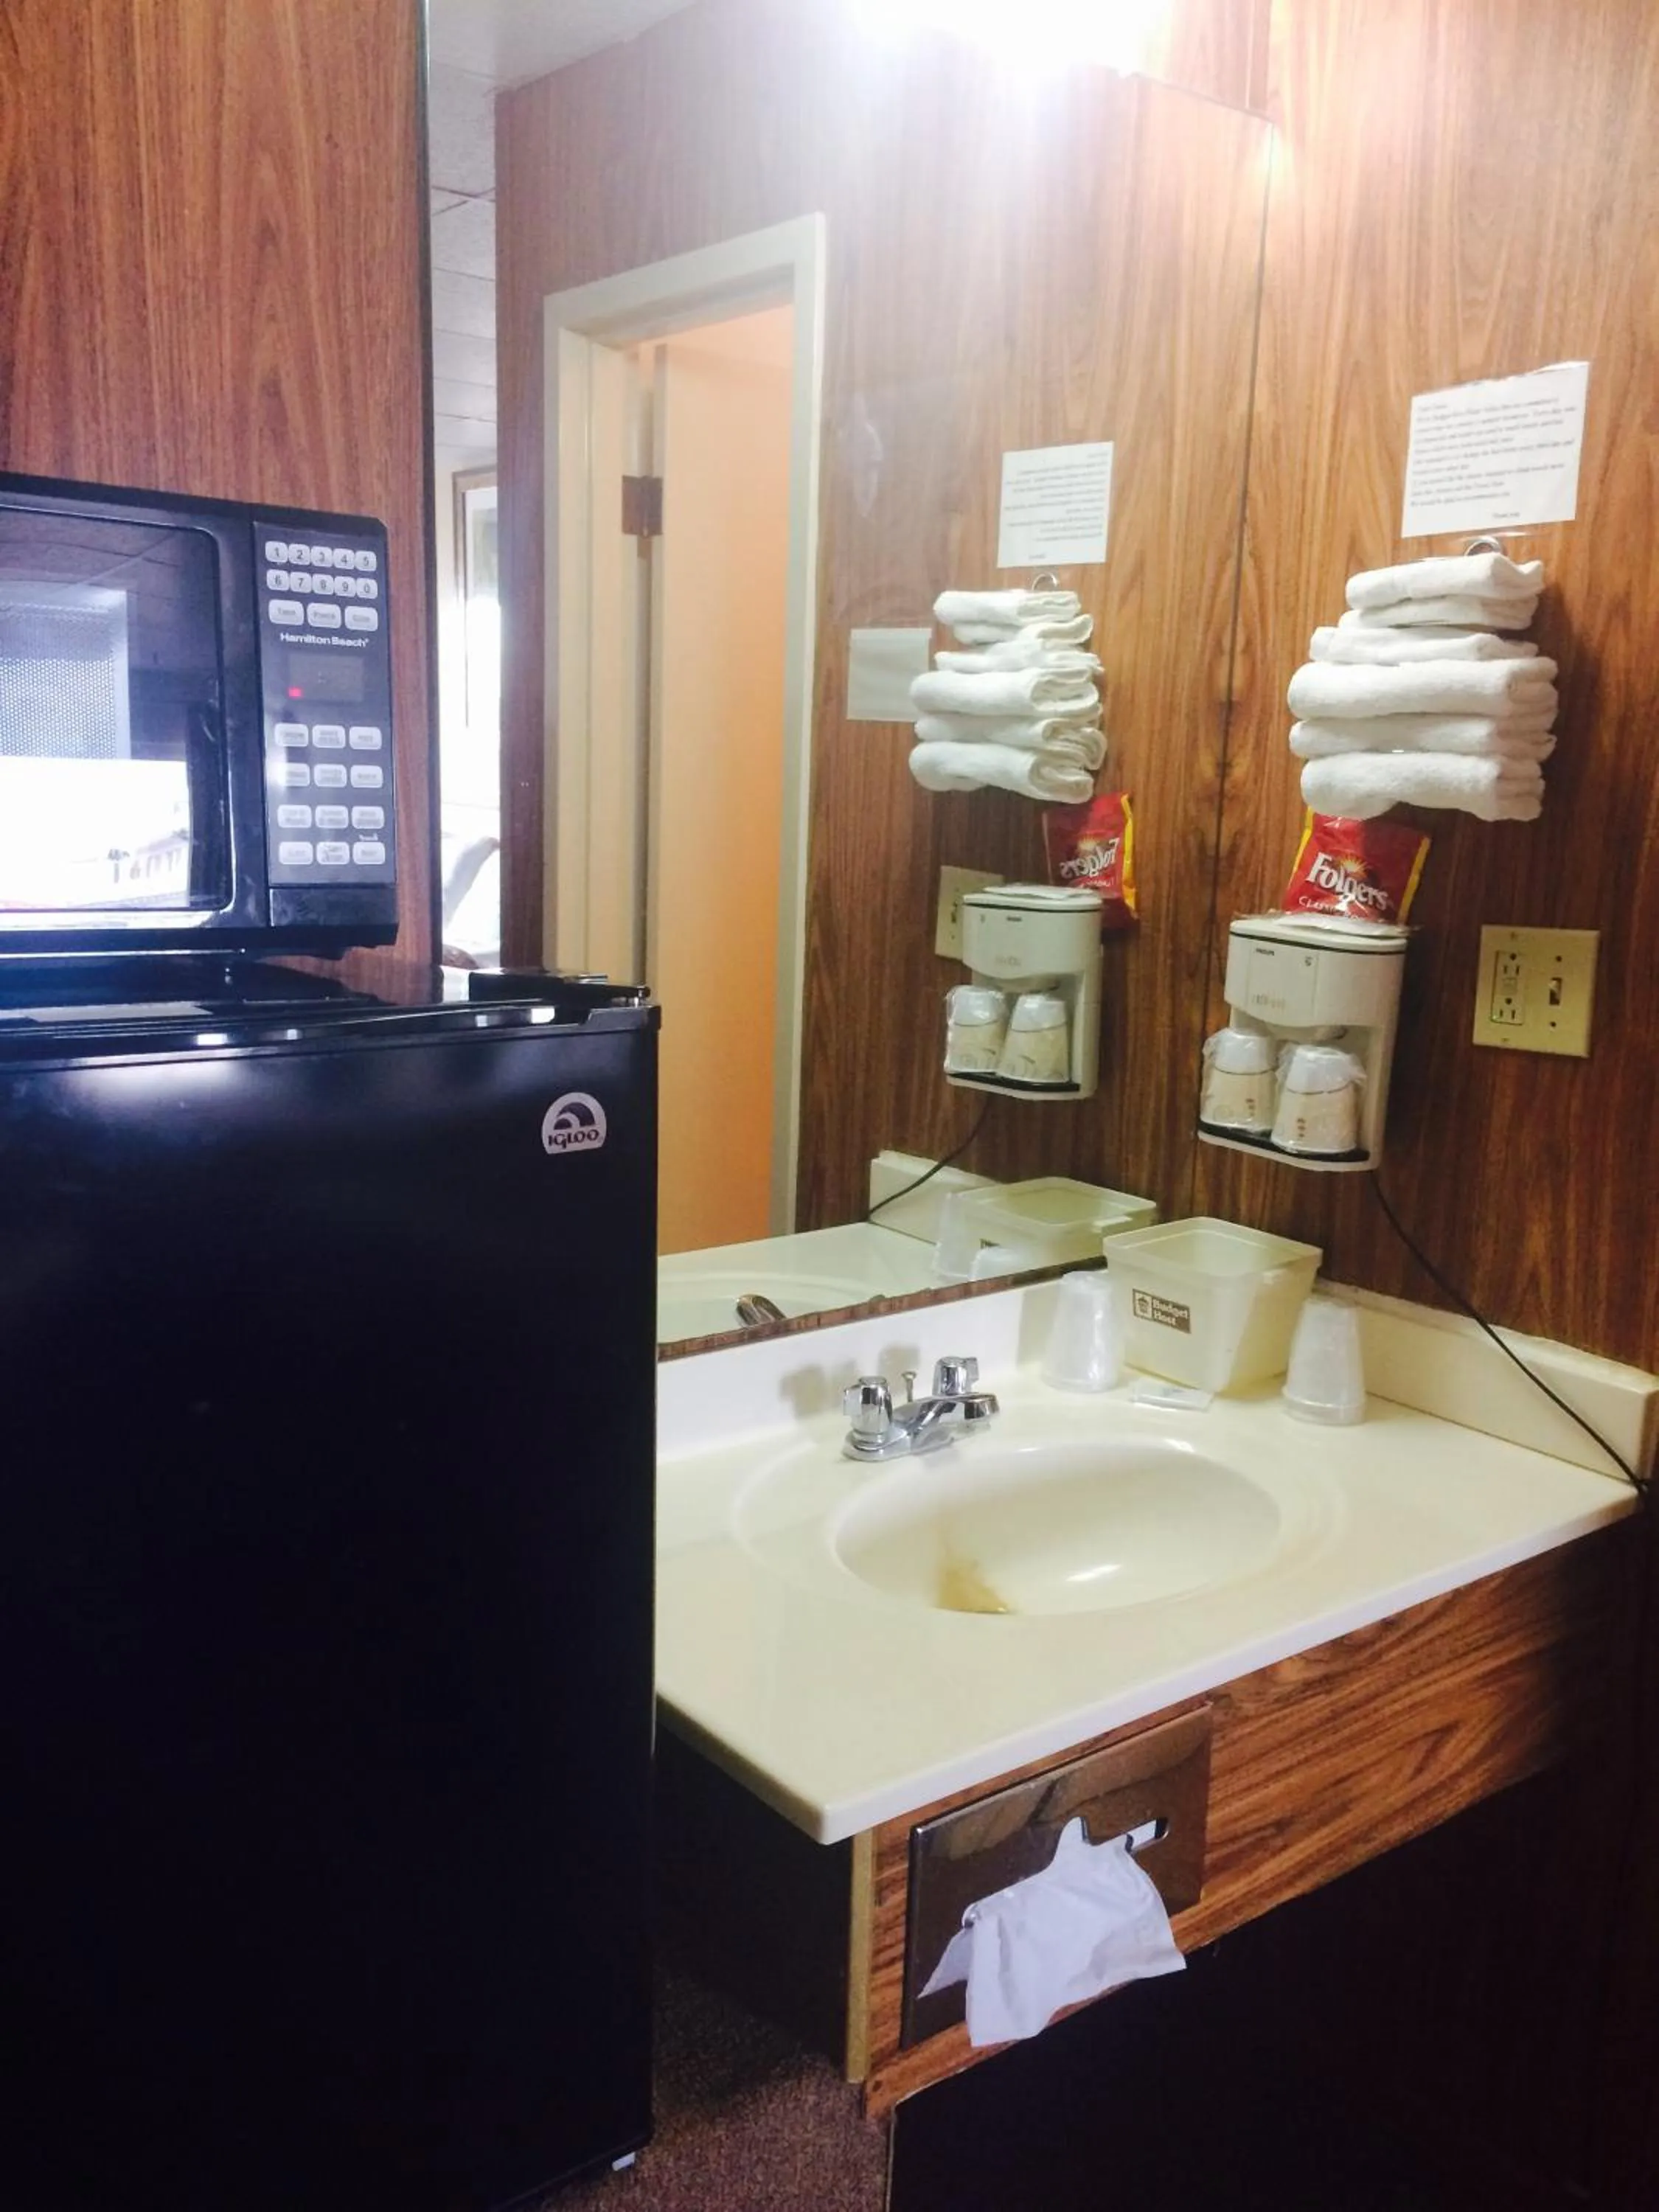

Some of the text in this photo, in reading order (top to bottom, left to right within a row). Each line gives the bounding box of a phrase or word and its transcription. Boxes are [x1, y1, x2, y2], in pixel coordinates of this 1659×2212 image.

[279, 631, 368, 648] Hamilton Beach
[1304, 852, 1389, 911] Folgers
[548, 1129, 599, 1149] IGLOO
[1152, 1298, 1188, 1319] Budget
[1154, 1310, 1177, 1326] Host
